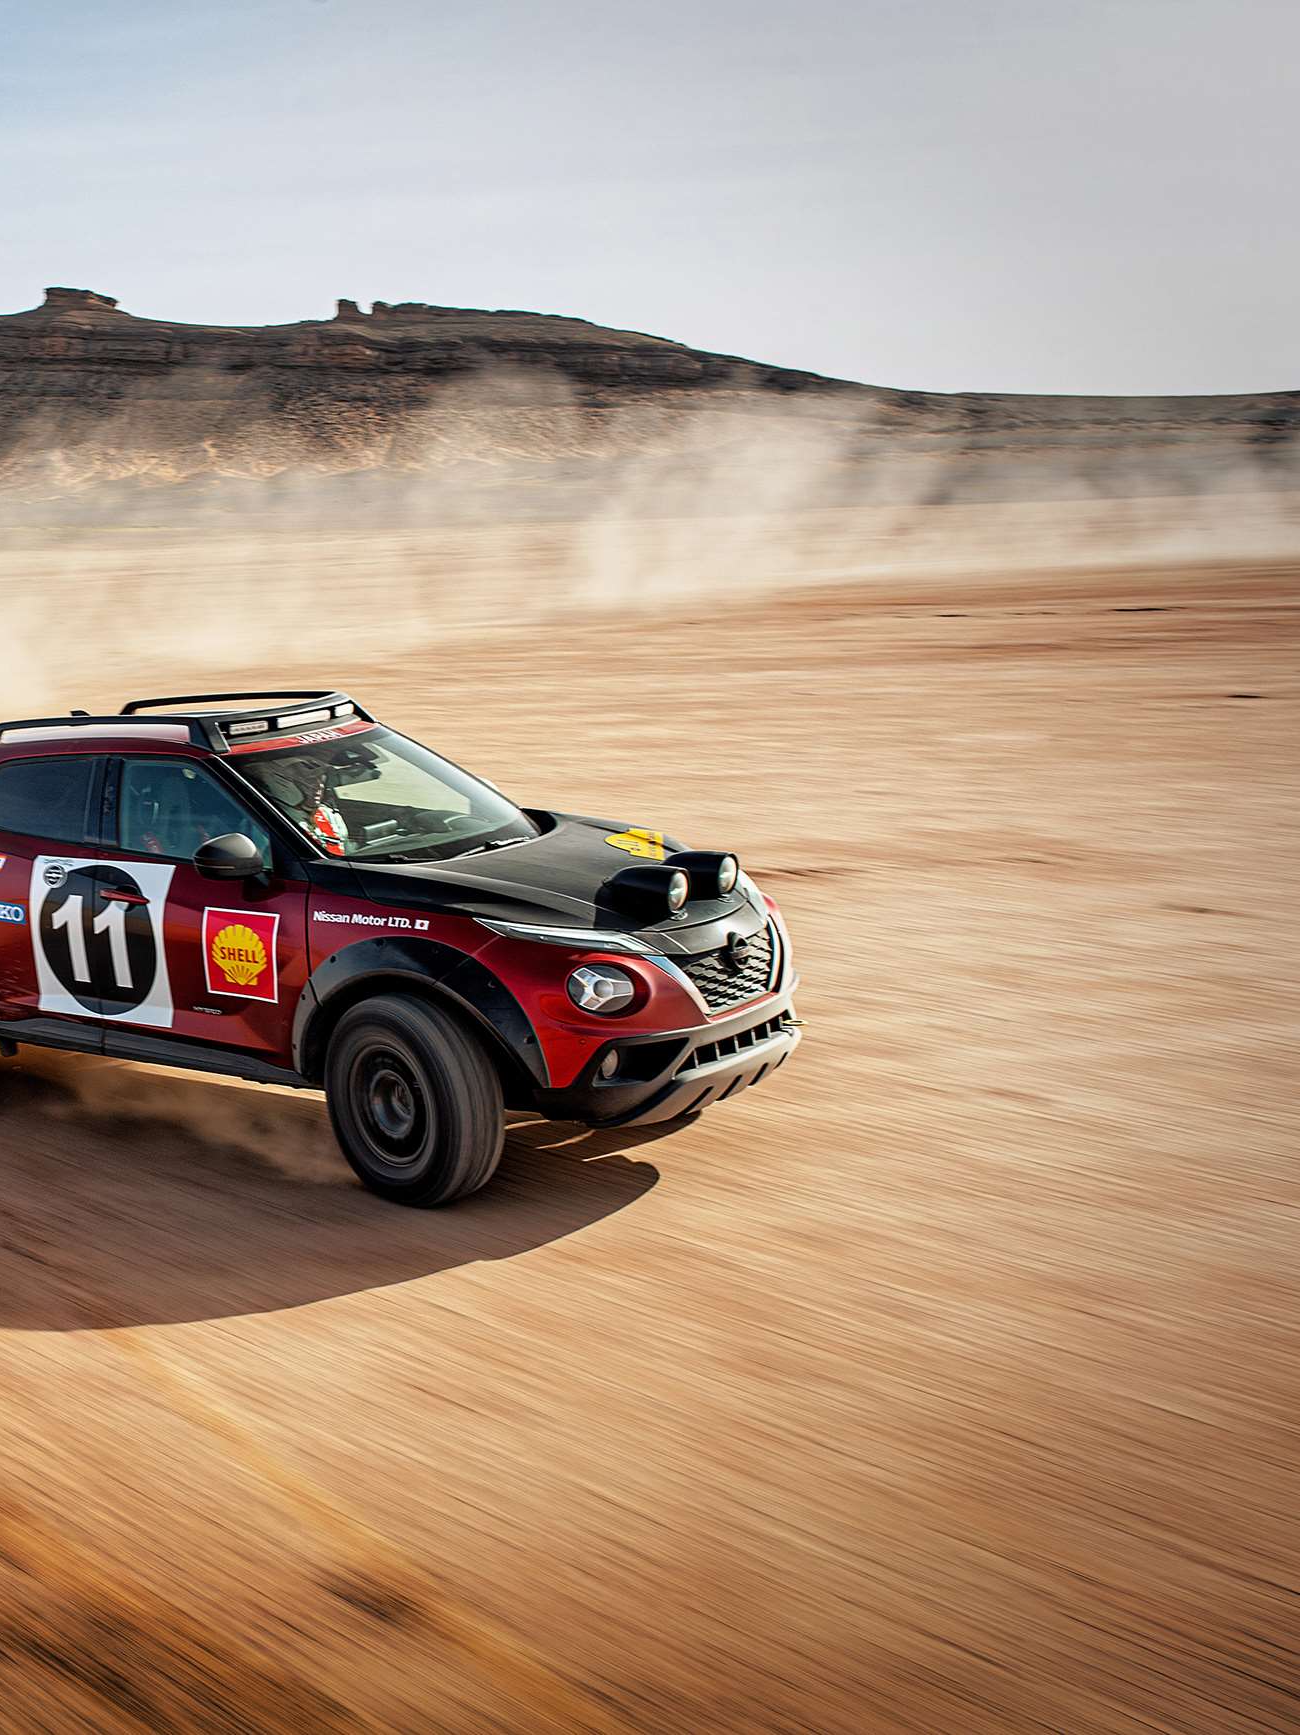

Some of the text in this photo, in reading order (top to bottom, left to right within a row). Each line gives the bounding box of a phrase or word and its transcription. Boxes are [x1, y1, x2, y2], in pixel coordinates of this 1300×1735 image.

[296, 728, 341, 745] JAPAN
[313, 910, 412, 929] Nissan Motor LTD.
[51, 894, 134, 988] 11
[219, 946, 260, 964] SHELL
